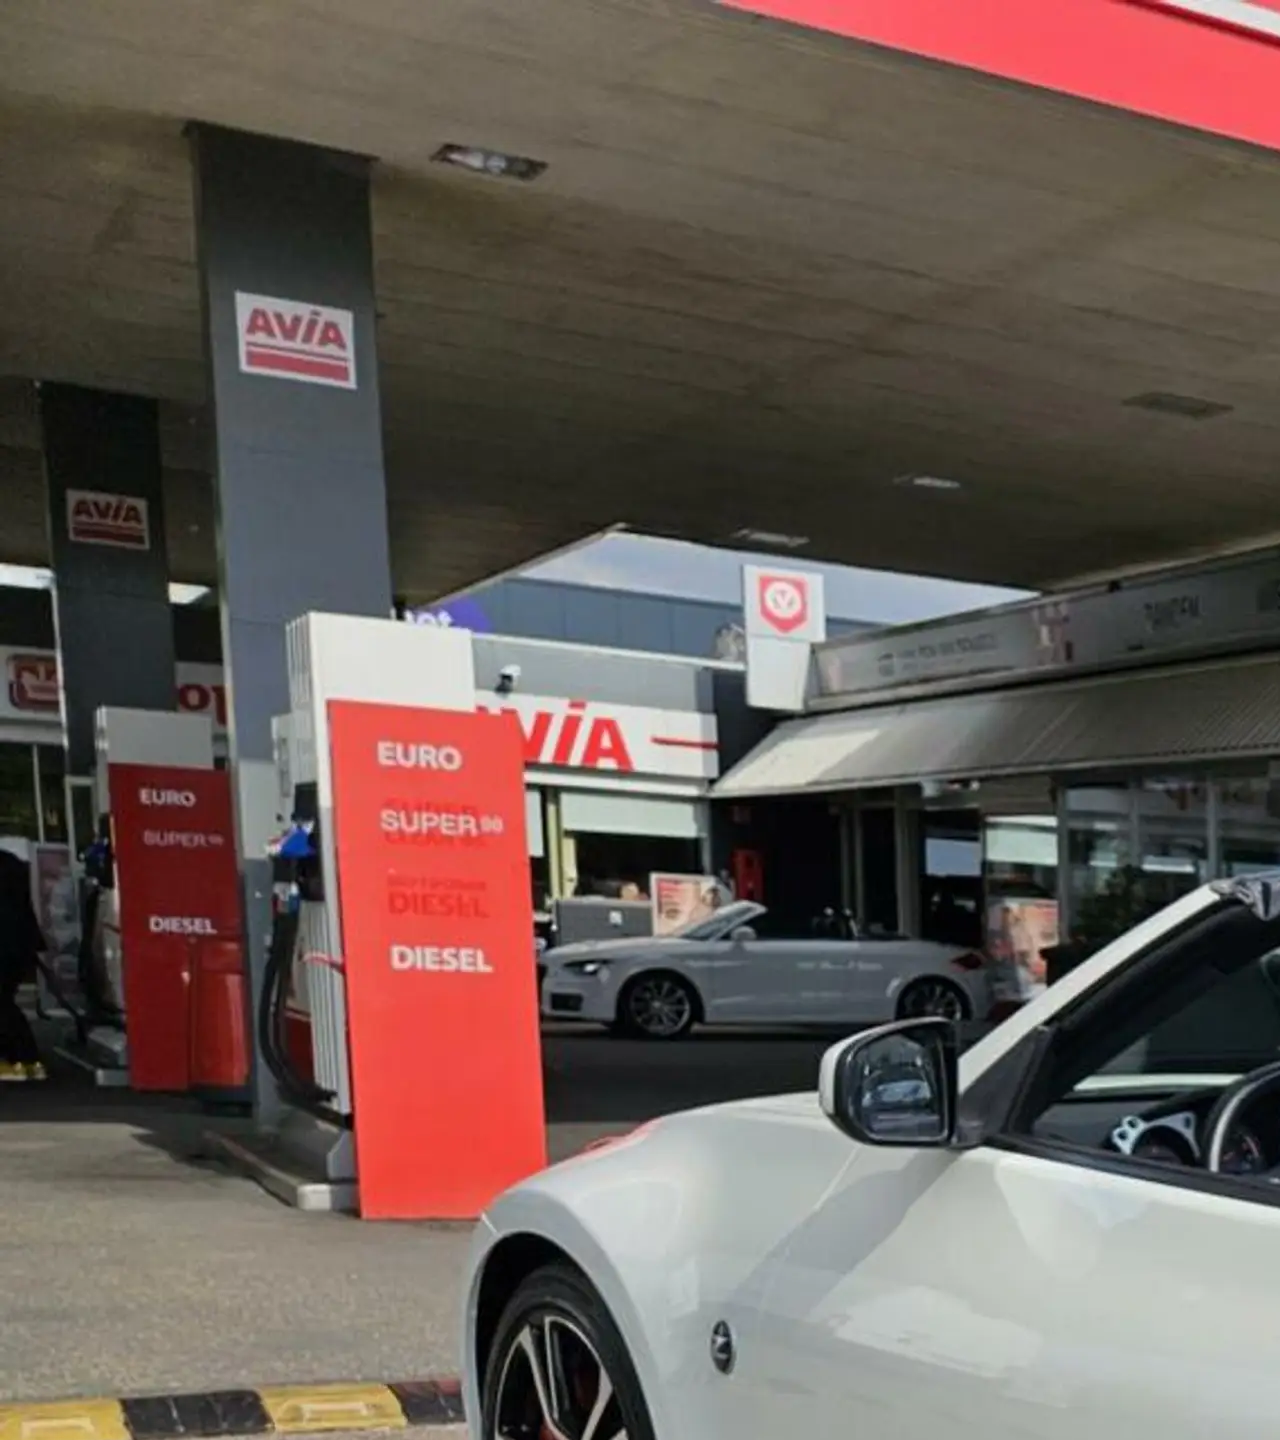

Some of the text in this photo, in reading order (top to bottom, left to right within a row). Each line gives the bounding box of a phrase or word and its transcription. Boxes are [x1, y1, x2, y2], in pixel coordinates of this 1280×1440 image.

[476, 700, 634, 774] VIA
[377, 741, 463, 771] EURO
[139, 788, 197, 808] EURO
[380, 808, 478, 838] SUPER
[149, 915, 219, 935] DIESEL
[390, 944, 495, 973] DIESEL
